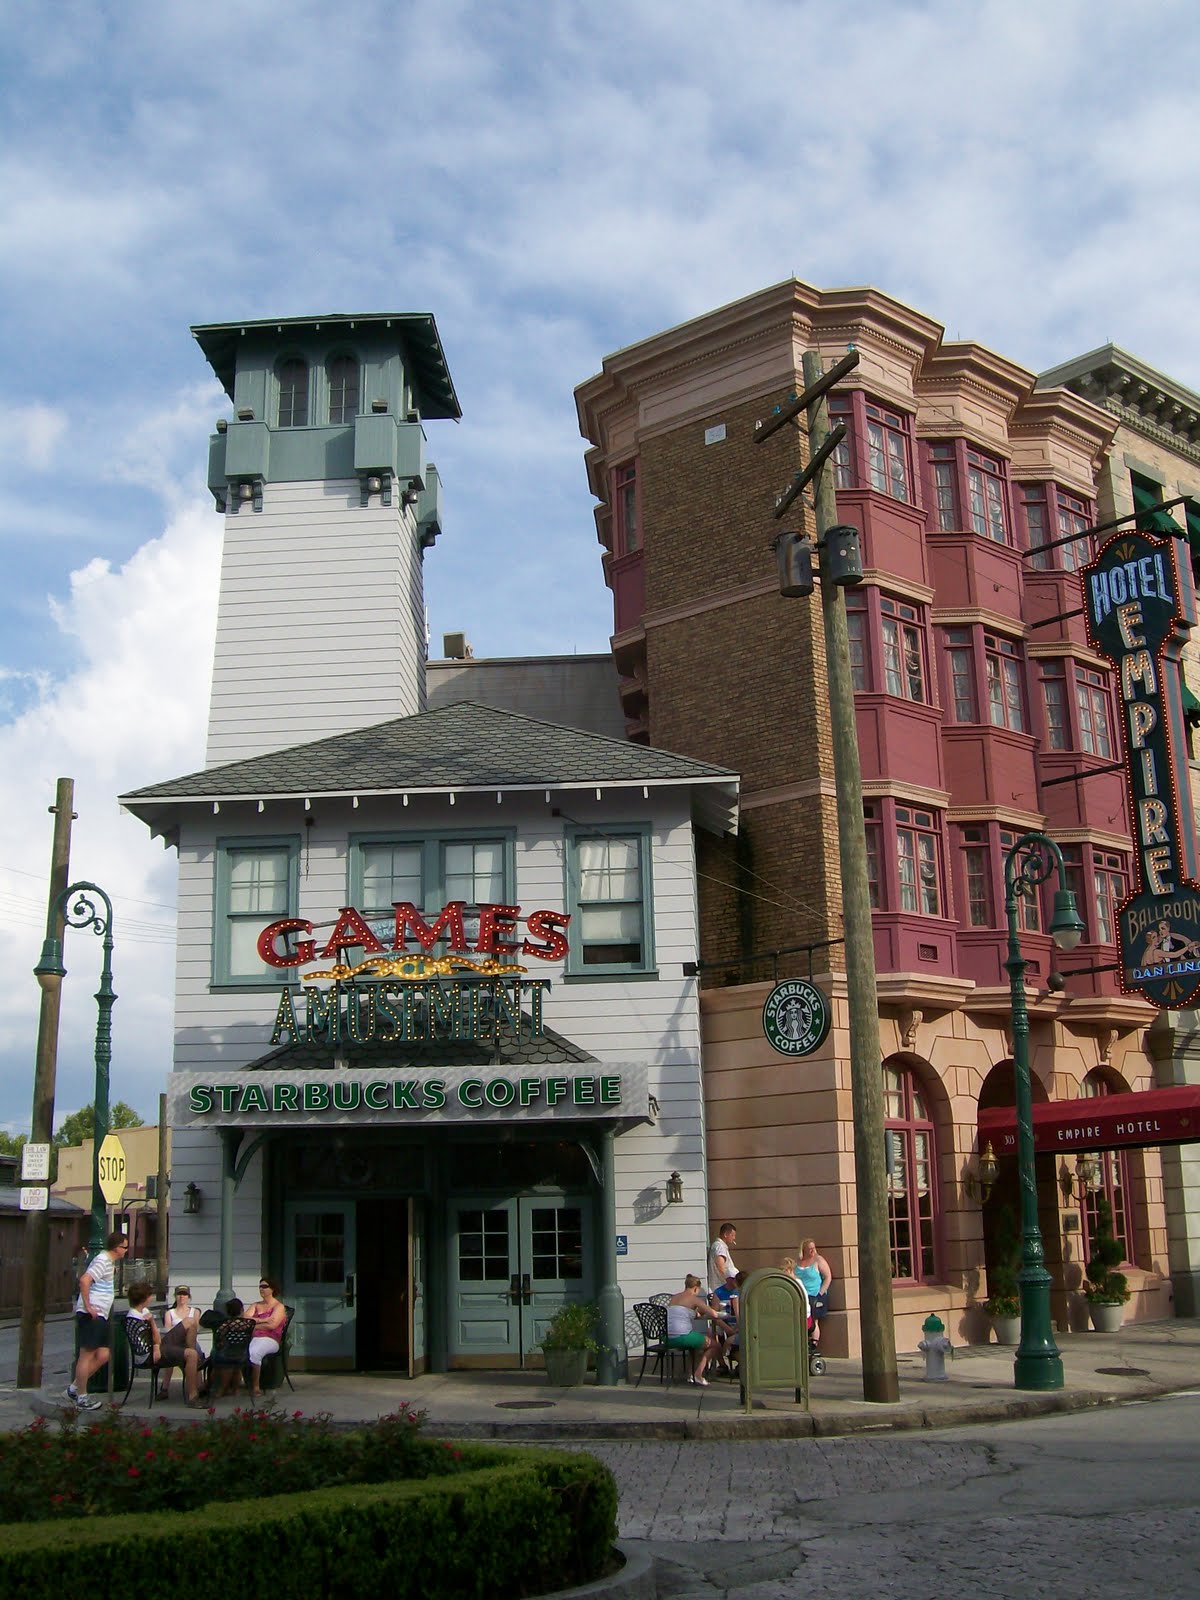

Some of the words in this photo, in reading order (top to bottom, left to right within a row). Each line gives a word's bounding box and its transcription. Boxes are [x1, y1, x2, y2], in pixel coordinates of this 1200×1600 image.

[1090, 554, 1173, 626] HOTEL
[1116, 601, 1174, 896] EMPIRE
[256, 900, 572, 968] GAMES
[1133, 960, 1200, 979] DANCIN
[268, 979, 552, 1045] AMUSEMENT
[767, 984, 820, 1018] STARBUCKS
[775, 1031, 816, 1051] COFFEE
[189, 1077, 446, 1114] STARBUCKS
[457, 1073, 622, 1108] COFFEE
[1004, 1134, 1015, 1145] 303
[1058, 1126, 1100, 1140] EMPIRE
[1116, 1120, 1161, 1135] HOTEL
[99, 1156, 125, 1181] STOP
